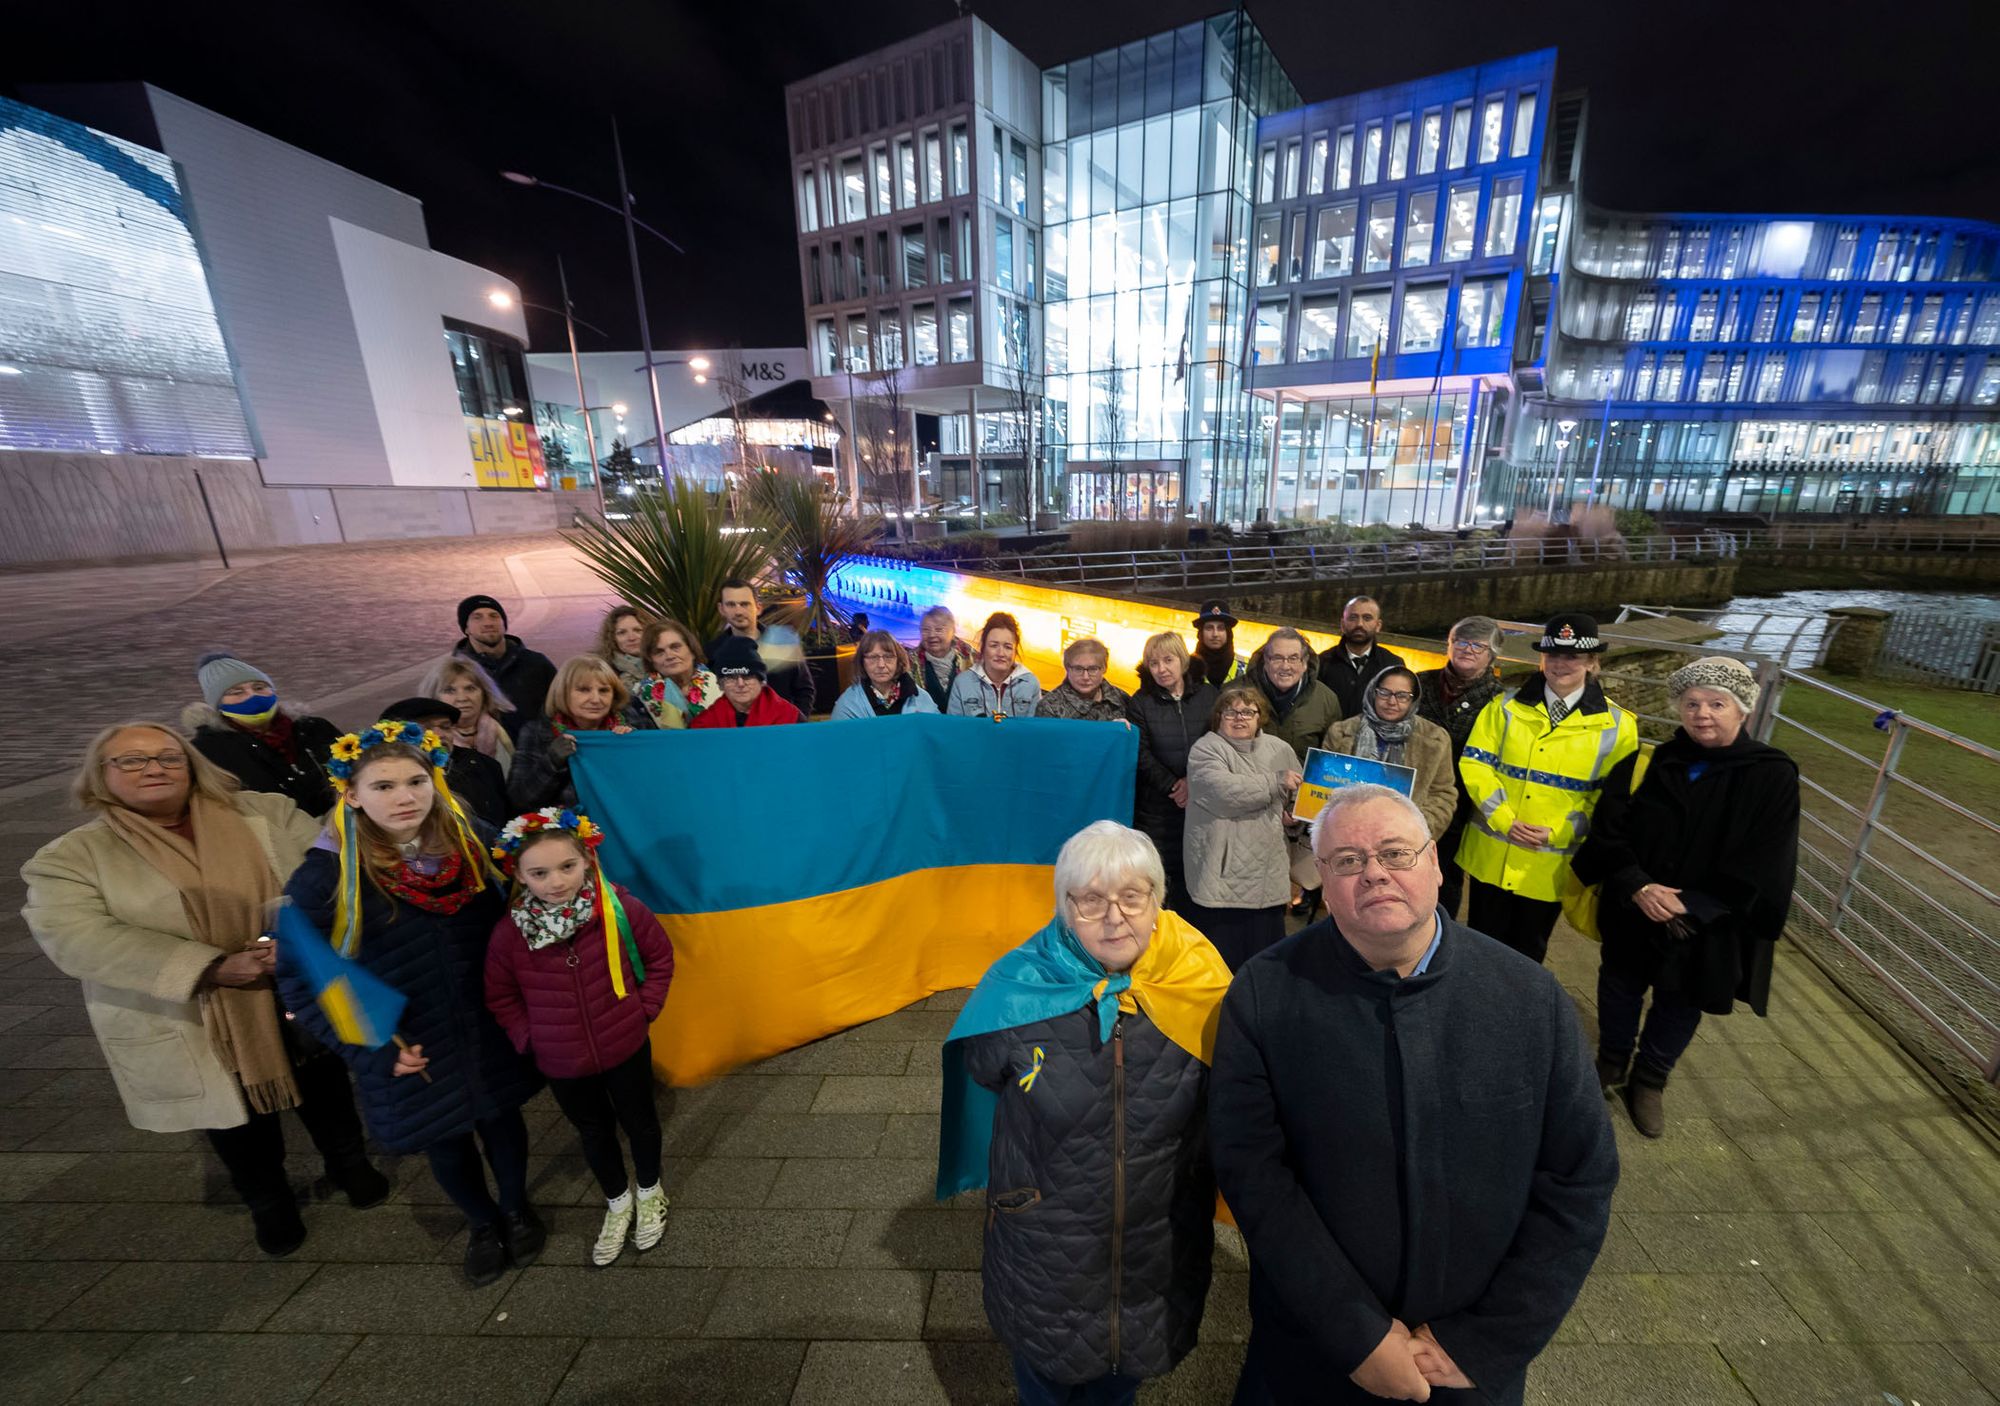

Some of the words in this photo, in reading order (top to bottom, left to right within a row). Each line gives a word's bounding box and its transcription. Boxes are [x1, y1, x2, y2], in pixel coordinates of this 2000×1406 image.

[741, 362, 786, 381] M&S
[467, 426, 504, 463] EAT
[1310, 789, 1332, 801] PRA
